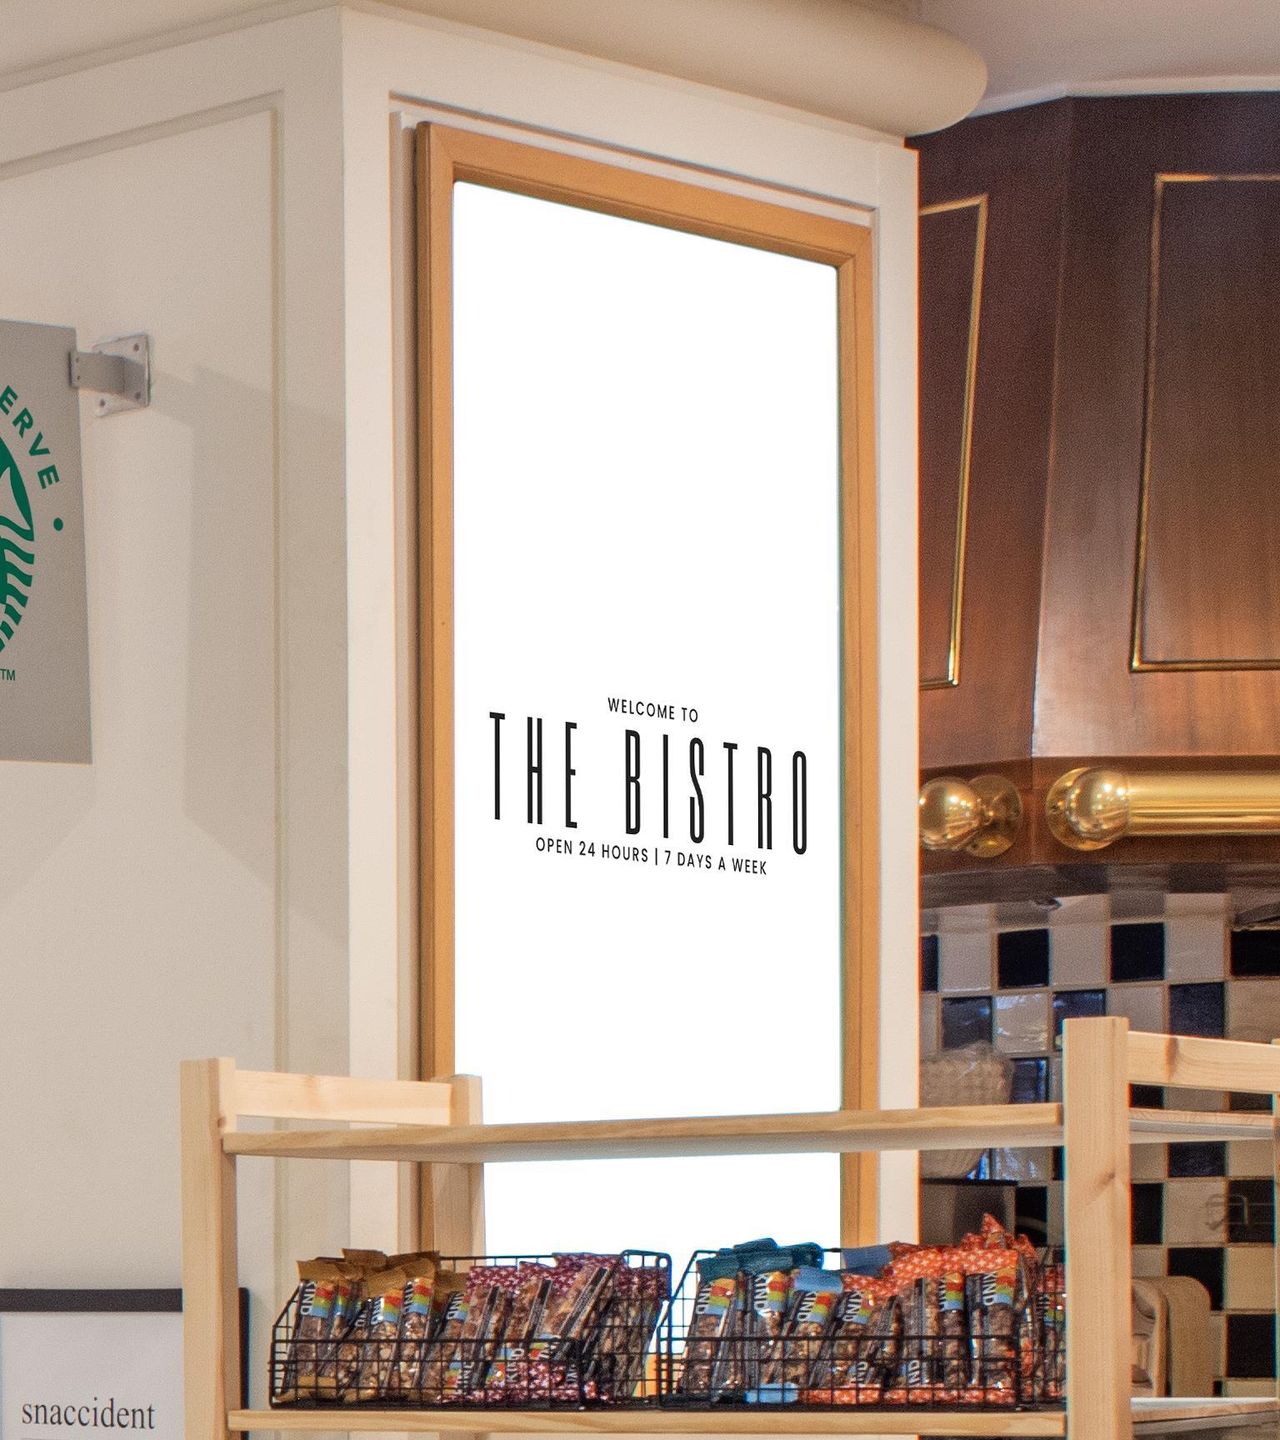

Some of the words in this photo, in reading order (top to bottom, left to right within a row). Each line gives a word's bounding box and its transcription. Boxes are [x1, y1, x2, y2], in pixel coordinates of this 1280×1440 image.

[607, 697, 675, 720] WELCOME
[681, 707, 698, 723] TO
[489, 711, 577, 829] THE
[625, 729, 807, 855] BISTRO
[536, 837, 572, 855] OPEN
[579, 841, 596, 858] 24
[602, 844, 649, 863] HOURS
[664, 850, 671, 865] 7
[677, 852, 712, 869] DAYS
[718, 856, 726, 870] A
[732, 858, 767, 875] WEEK
[21, 1397, 156, 1430] snaccident
